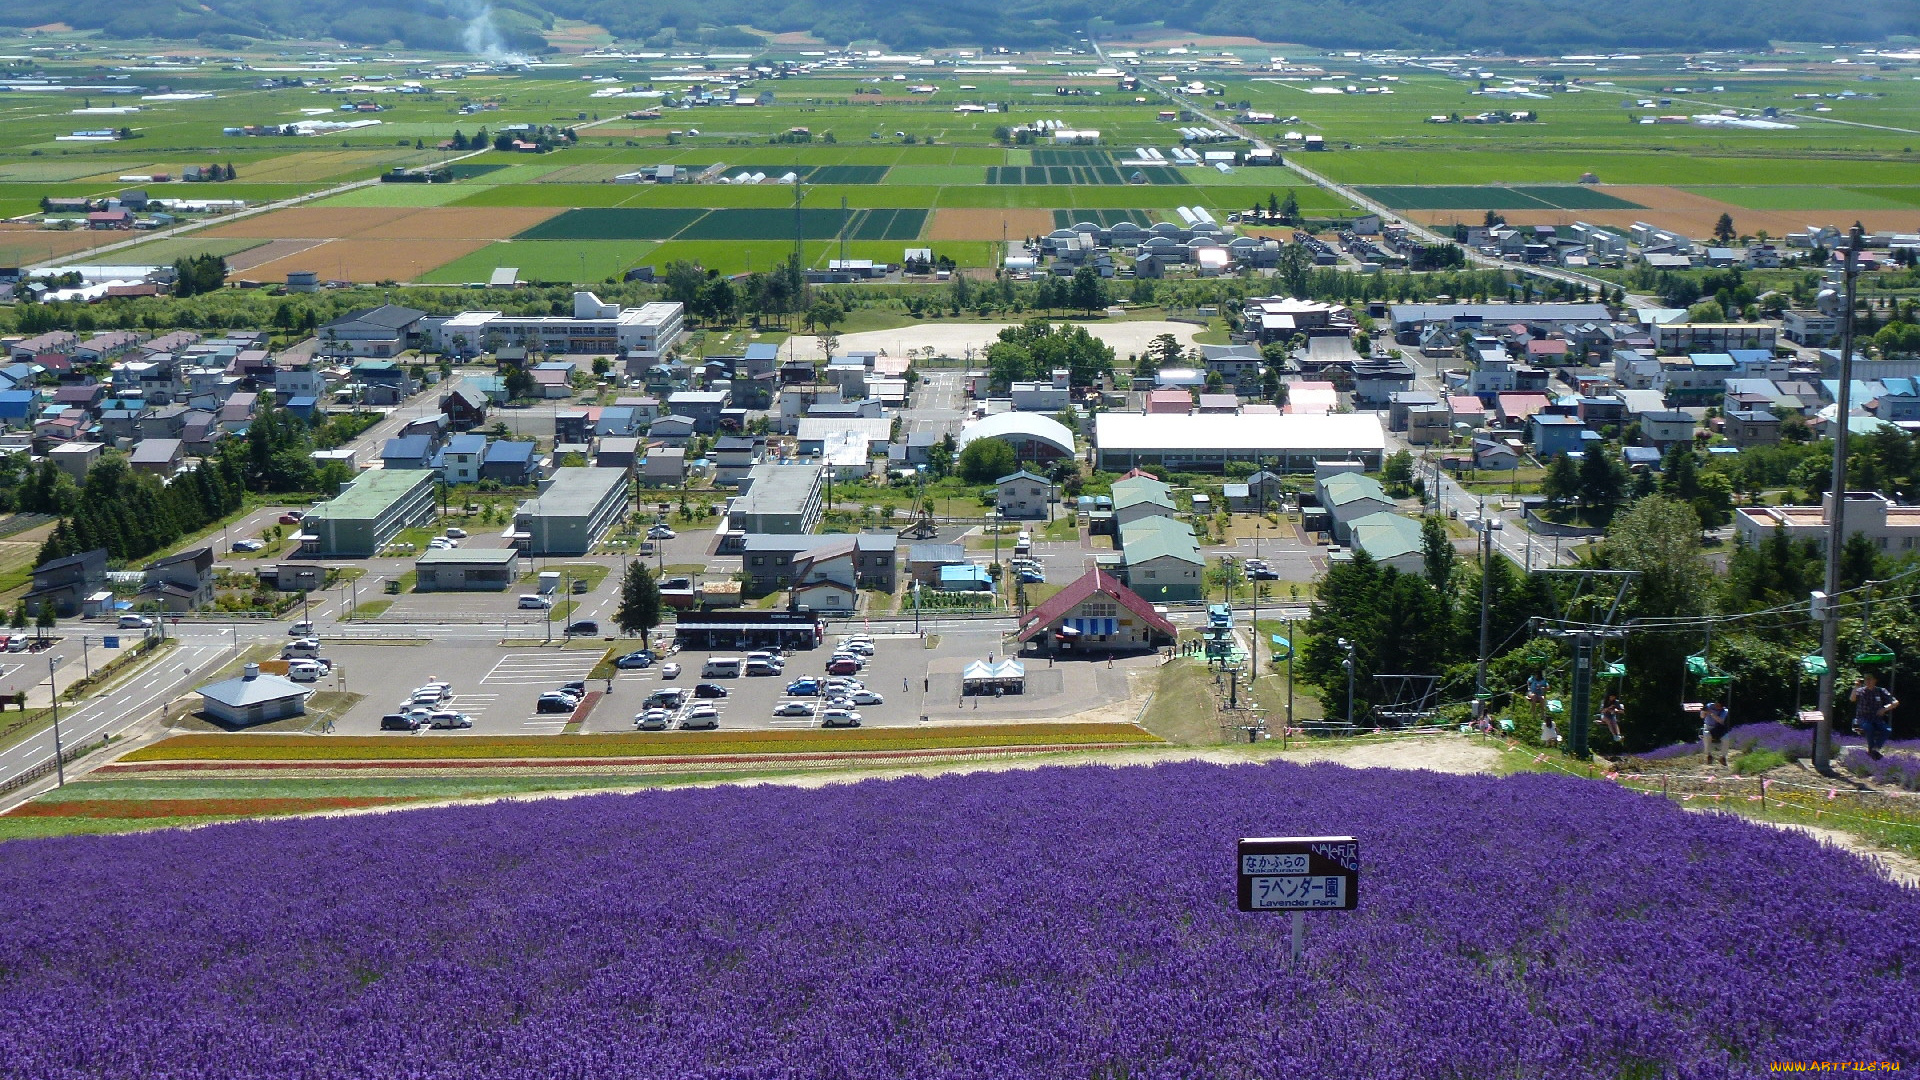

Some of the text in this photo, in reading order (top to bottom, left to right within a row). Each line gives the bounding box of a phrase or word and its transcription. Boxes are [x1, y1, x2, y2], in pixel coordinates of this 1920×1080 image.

[1245, 856, 1305, 868] なかふらの
[1258, 877, 1338, 898] ラベンダー園
[1259, 899, 1309, 907] Lavender
